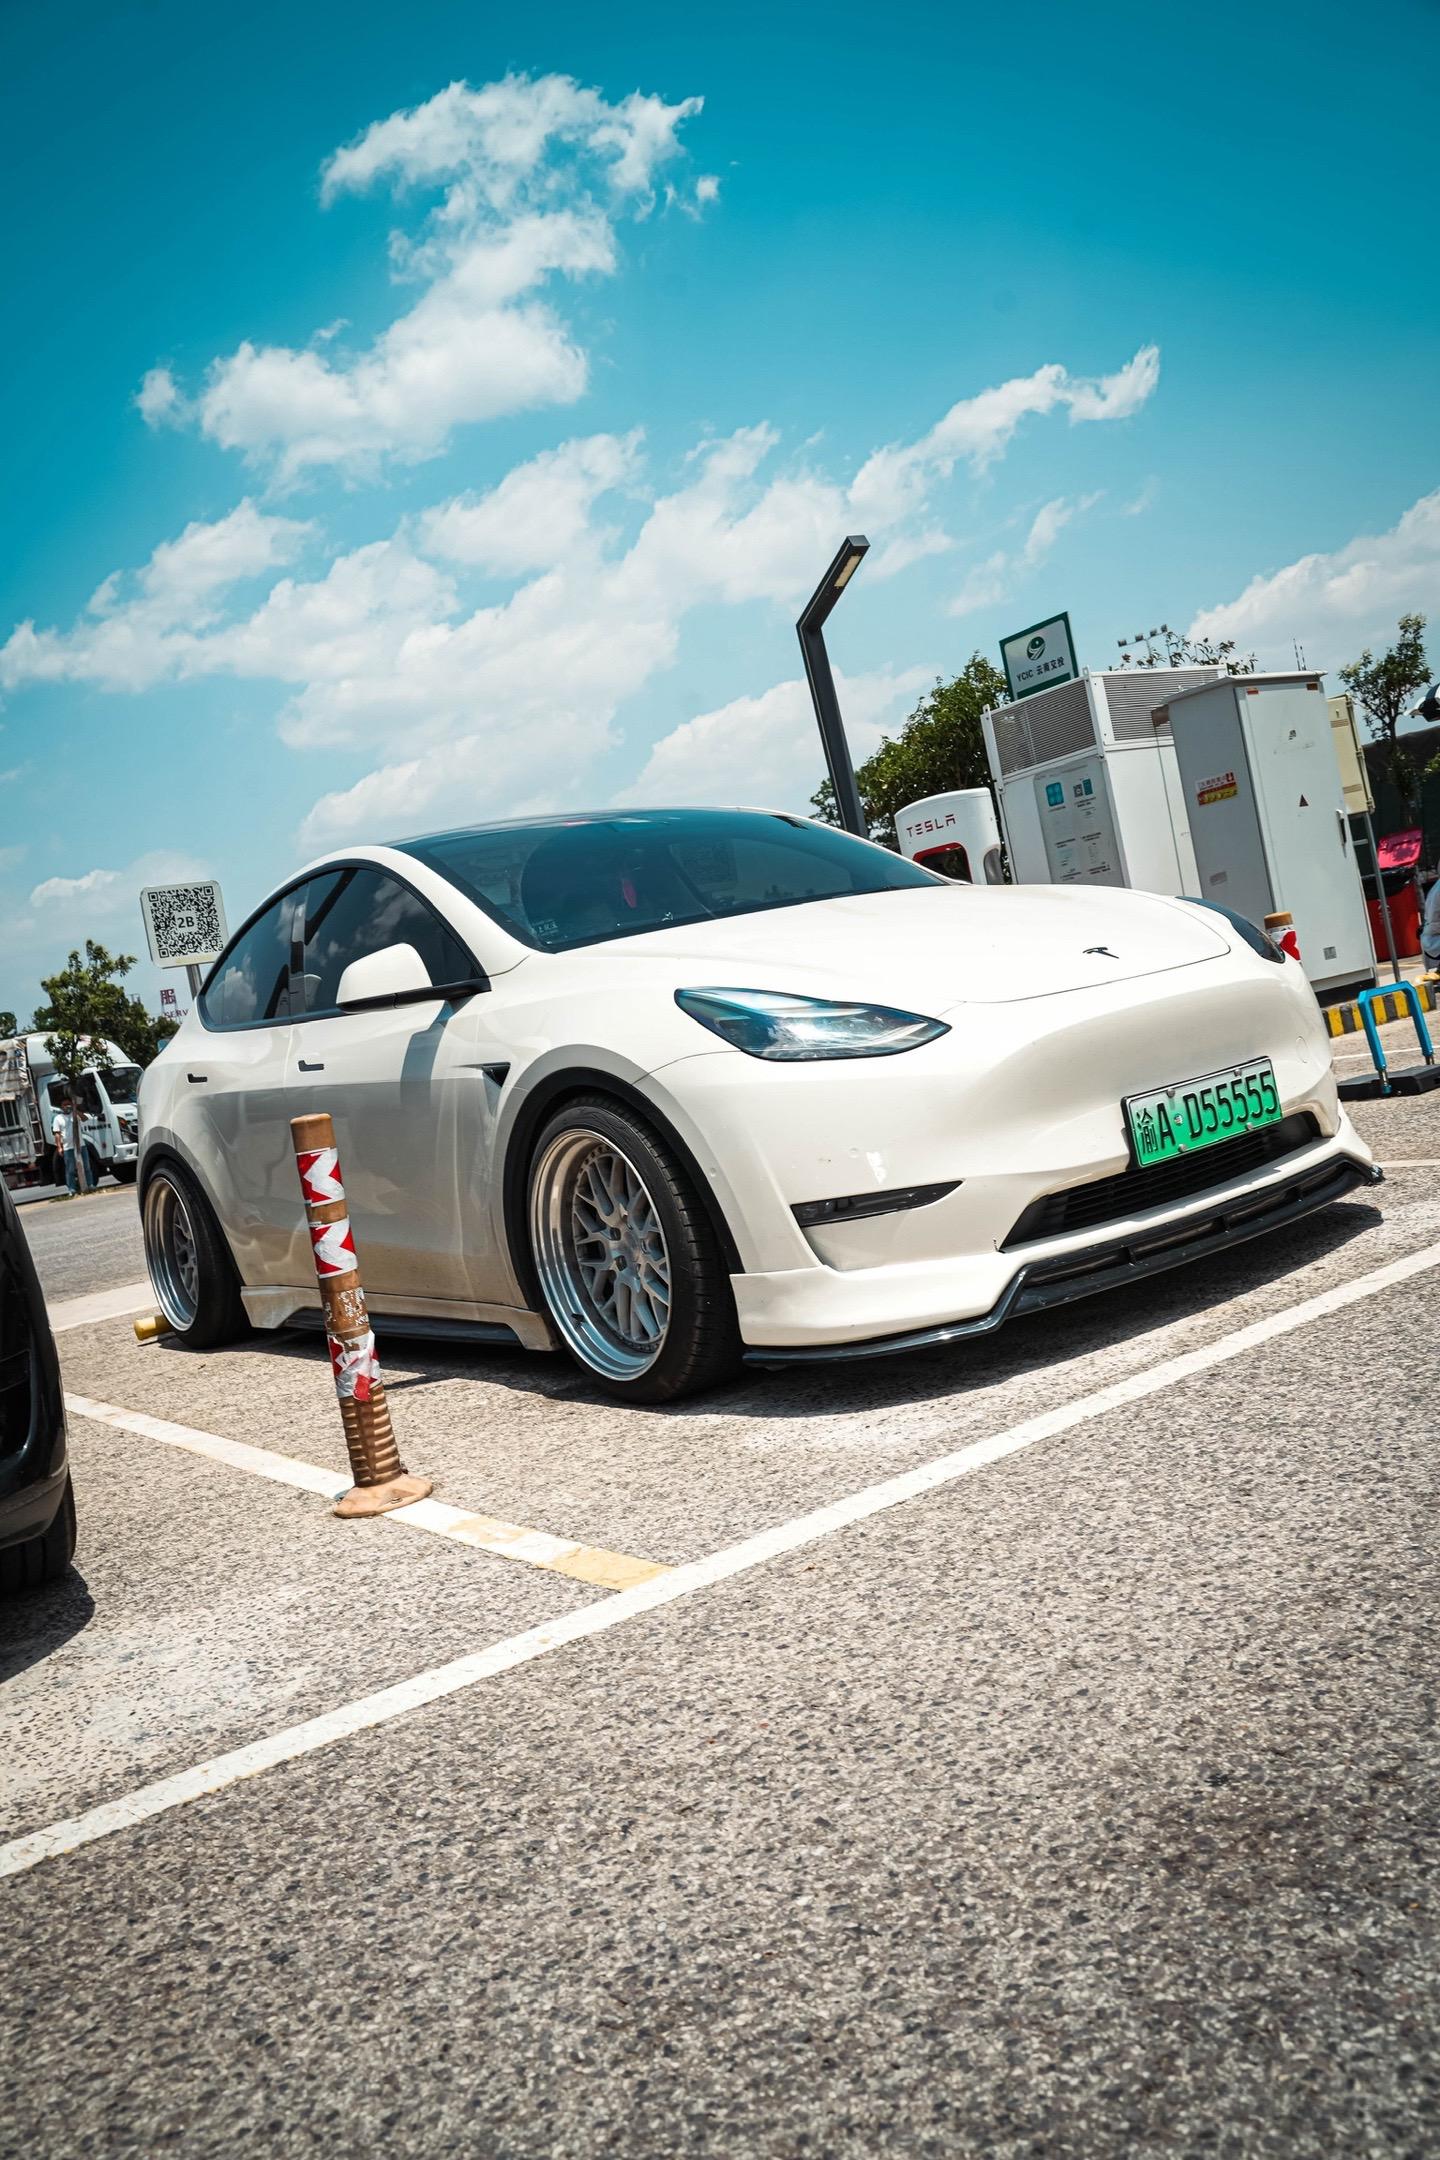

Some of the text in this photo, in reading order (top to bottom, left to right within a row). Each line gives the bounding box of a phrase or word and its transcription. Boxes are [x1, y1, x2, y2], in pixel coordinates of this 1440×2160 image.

[1016, 669, 1034, 682] YCIC
[906, 814, 956, 838] TESLA
[177, 916, 195, 928] 2B
